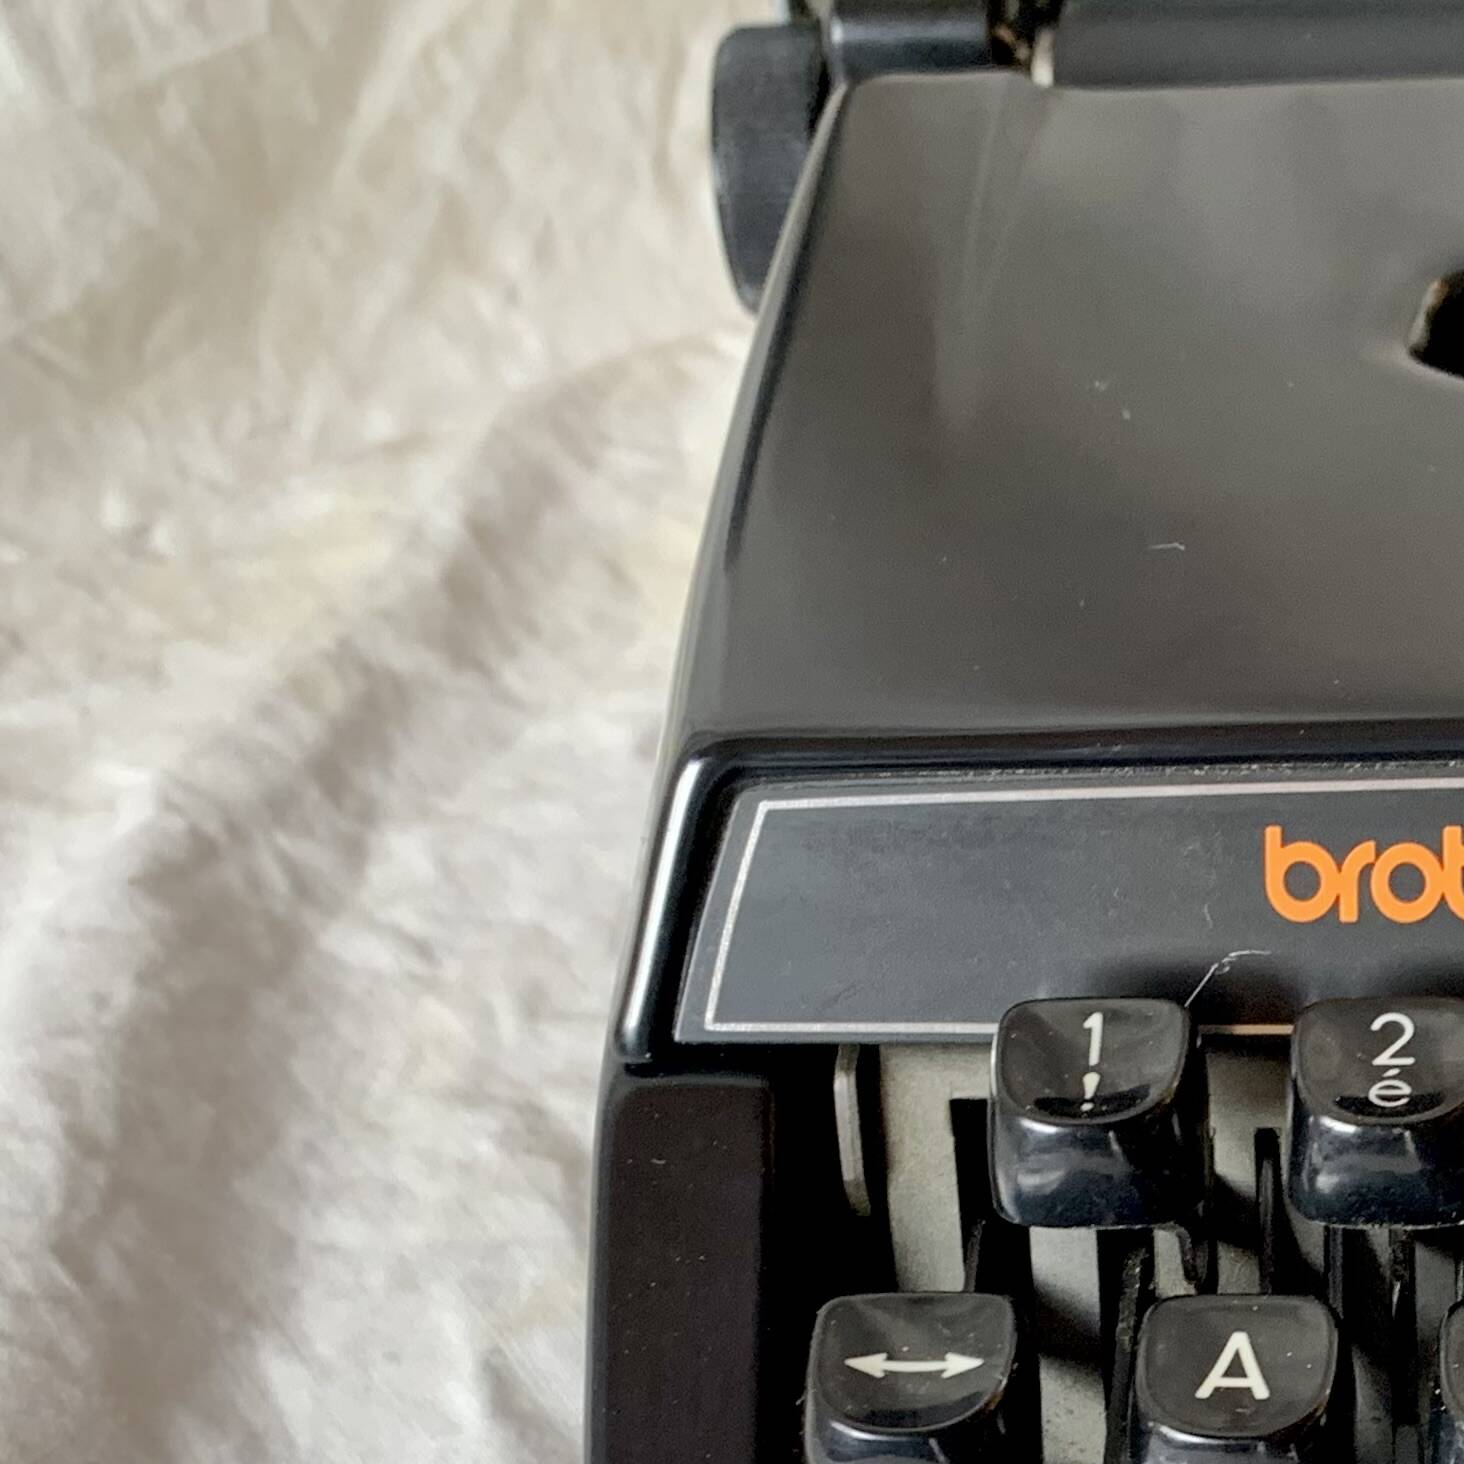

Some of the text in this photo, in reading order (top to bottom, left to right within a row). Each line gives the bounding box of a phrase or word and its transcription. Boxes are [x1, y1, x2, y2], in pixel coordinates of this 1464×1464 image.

[1083, 1012, 1103, 1066] 1
[1370, 1012, 1415, 1067] 2
[1081, 1072, 1100, 1111] !
[1368, 1067, 1413, 1108] é
[1195, 1331, 1270, 1400] A
